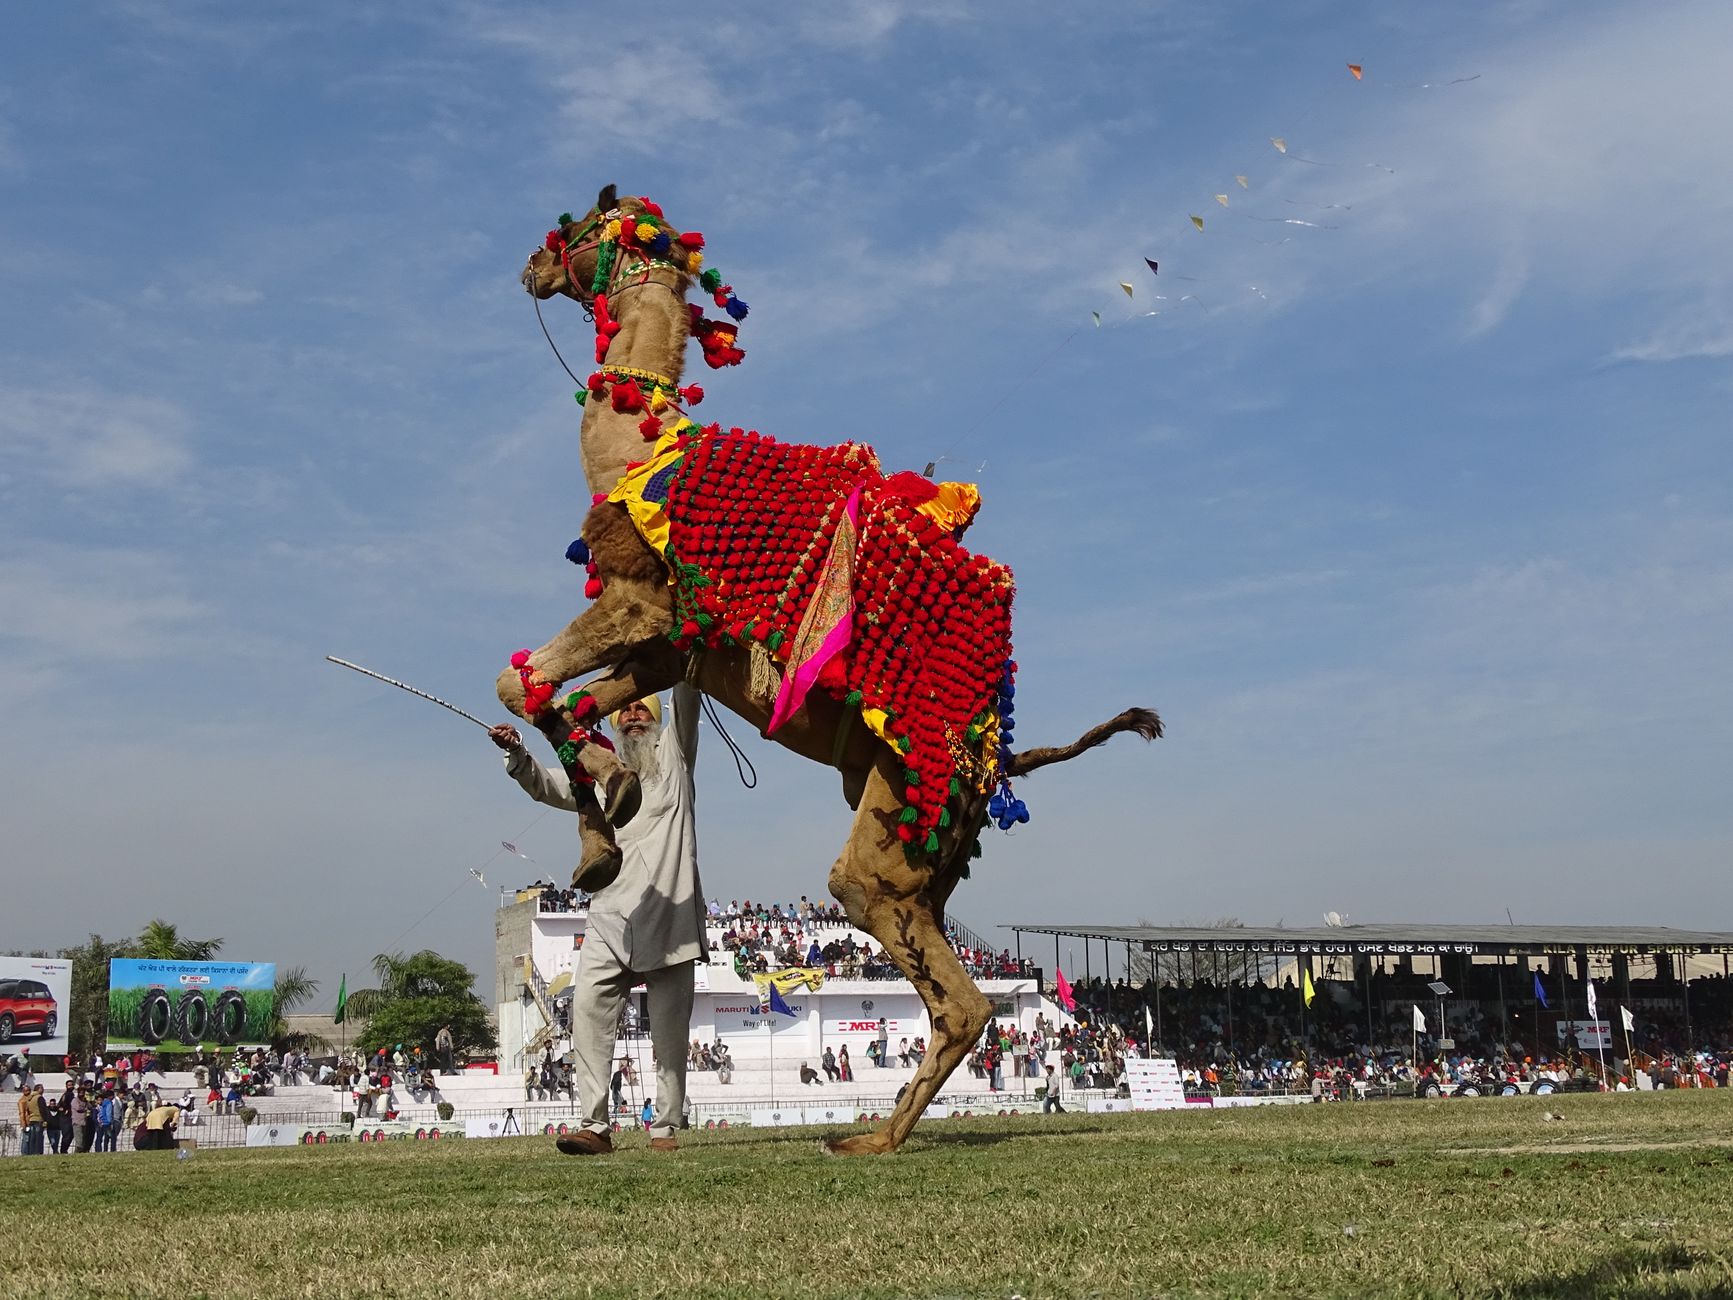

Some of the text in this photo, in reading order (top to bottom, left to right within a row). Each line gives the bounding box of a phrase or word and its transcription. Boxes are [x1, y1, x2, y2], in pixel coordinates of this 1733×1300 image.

[1543, 944, 1576, 953] KILA
[1586, 944, 1638, 953] RAIPUR
[1647, 944, 1701, 953] SPORTS
[743, 1019, 755, 1027] Way
